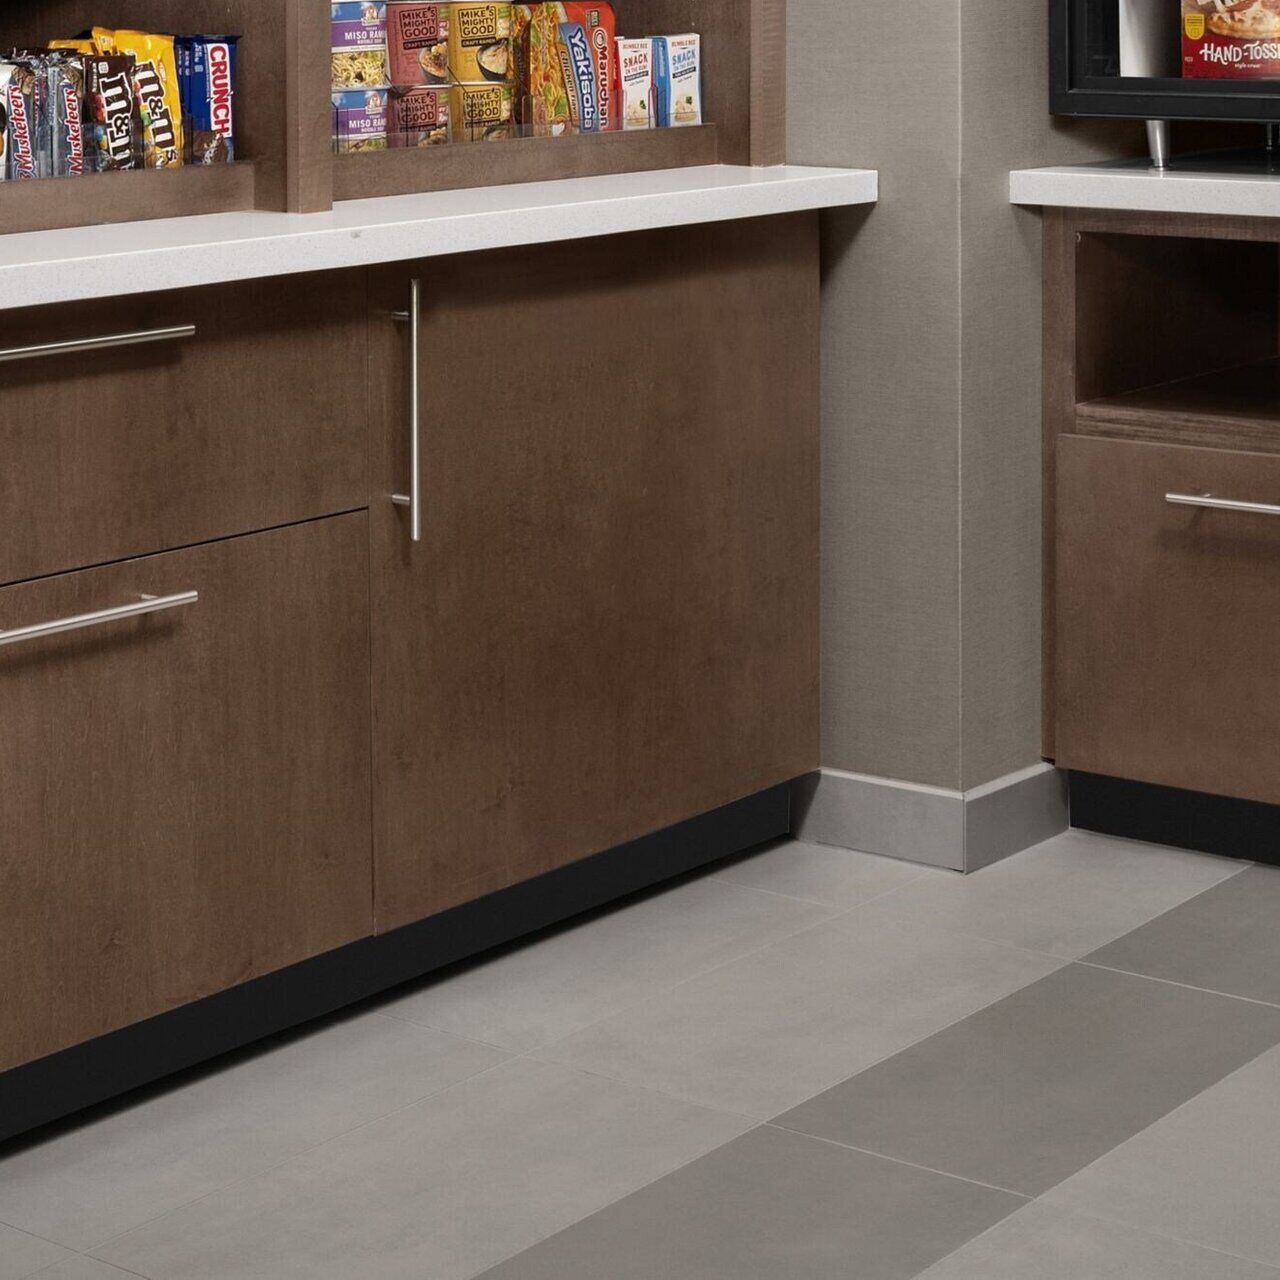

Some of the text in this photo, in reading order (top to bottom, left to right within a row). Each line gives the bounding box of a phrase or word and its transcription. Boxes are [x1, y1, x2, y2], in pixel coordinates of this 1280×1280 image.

[404, 28, 435, 38] GOOD
[463, 25, 494, 36] GOOD
[569, 27, 595, 129] Yakisoba
[623, 53, 648, 68] SNACK
[672, 50, 696, 65] SNACK
[209, 45, 231, 136] CRUNCH
[598, 47, 609, 128] Maruchan
[9, 86, 34, 172] Musketeers
[65, 89, 83, 170] Musketeers
[349, 120, 370, 128] MISO
